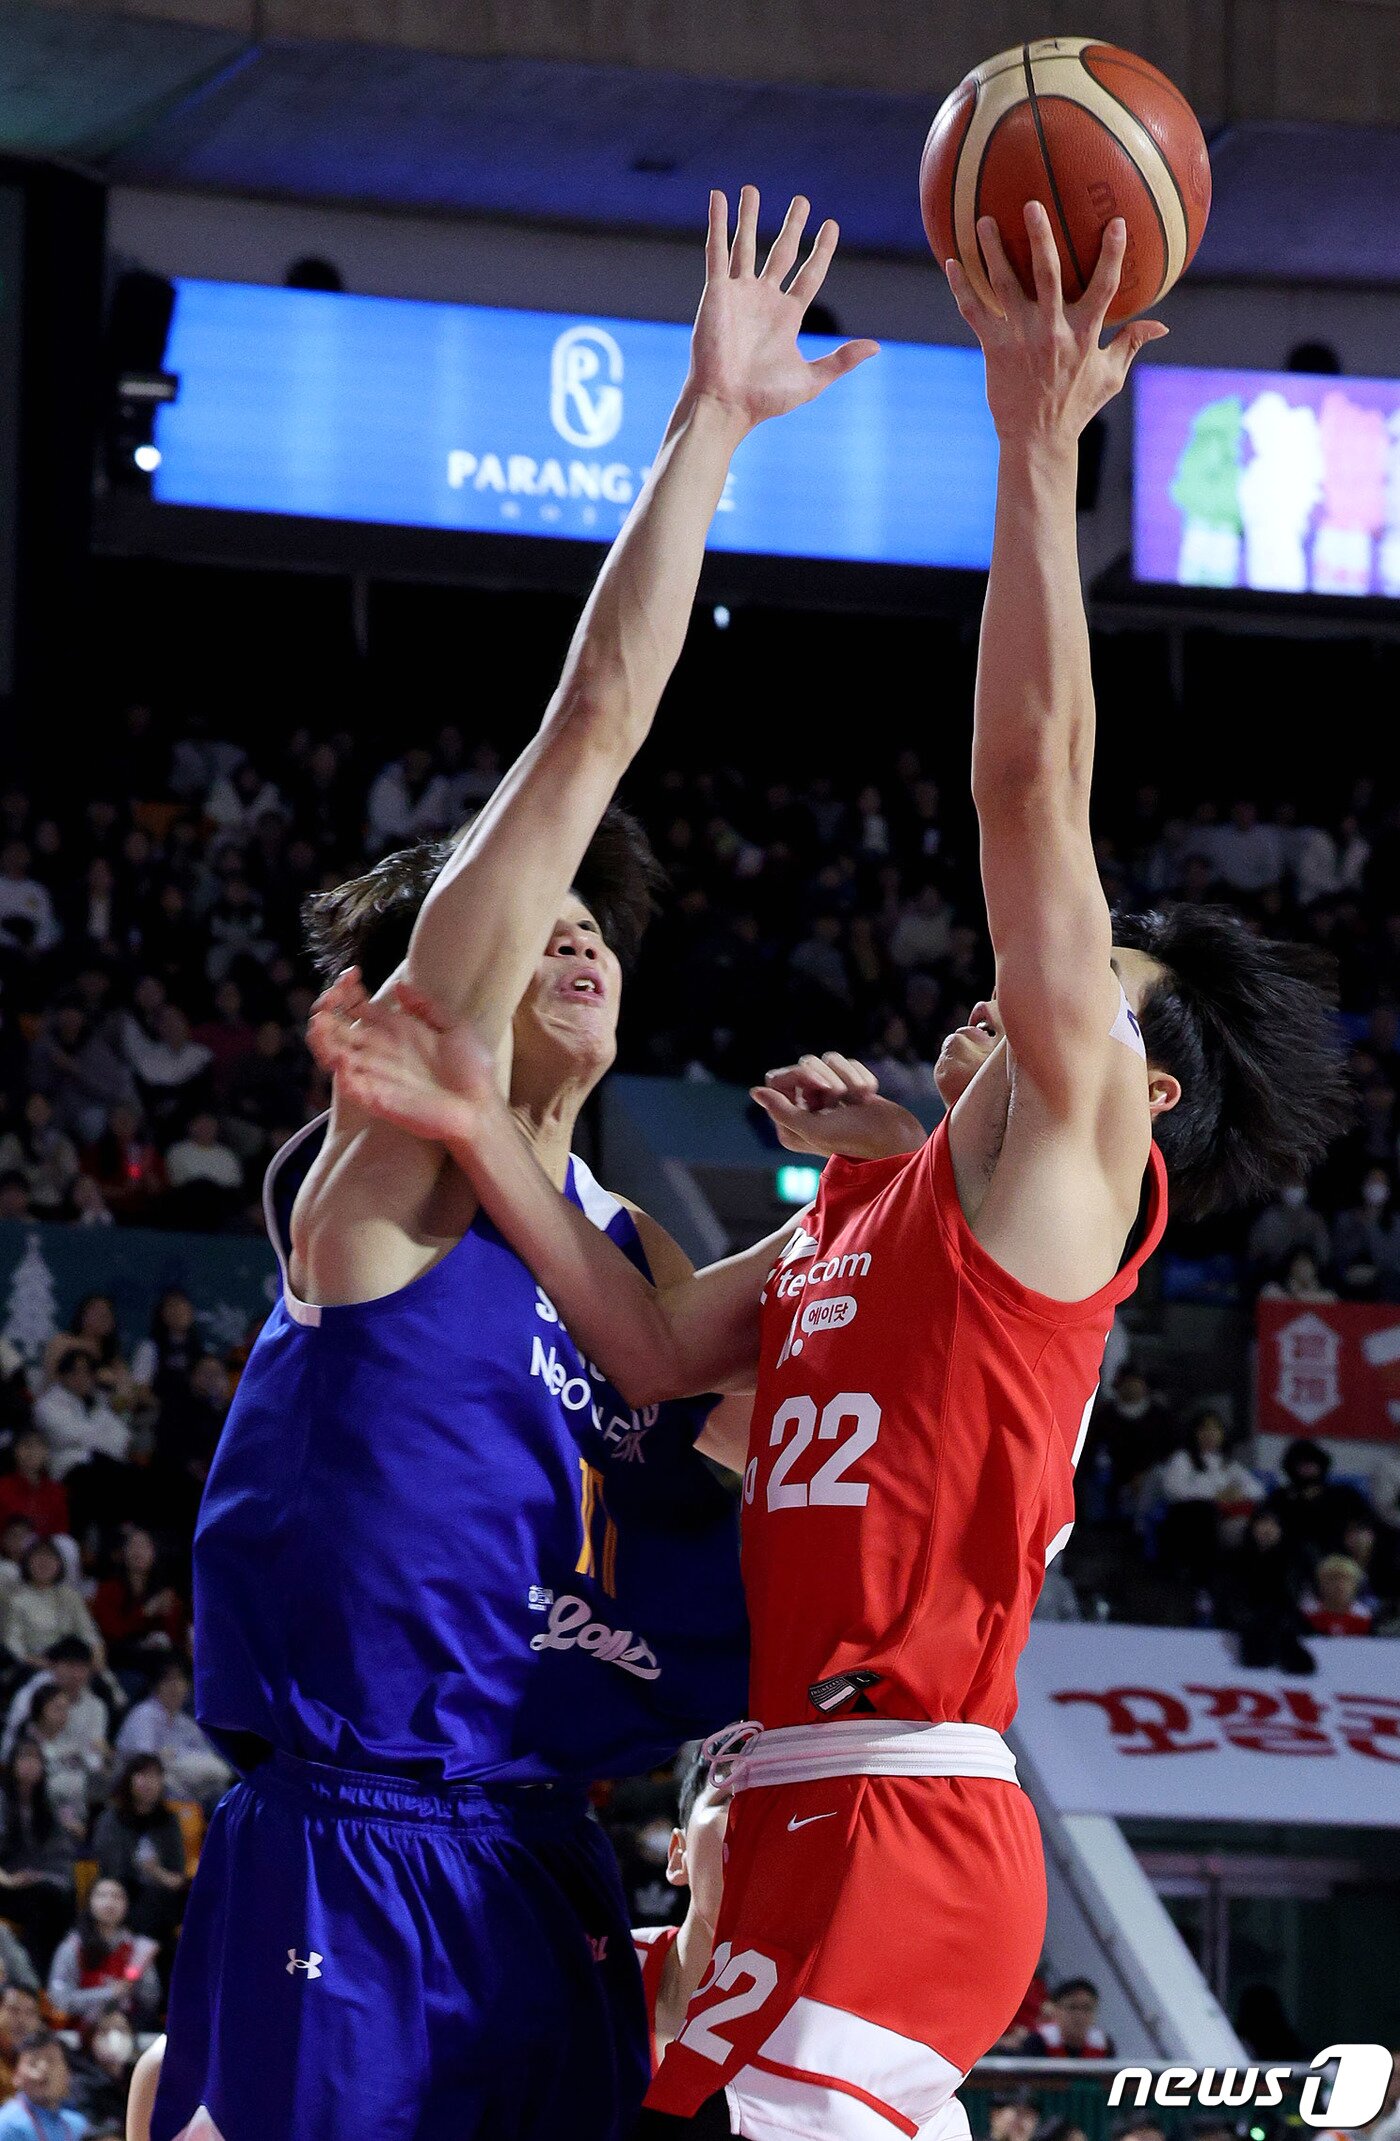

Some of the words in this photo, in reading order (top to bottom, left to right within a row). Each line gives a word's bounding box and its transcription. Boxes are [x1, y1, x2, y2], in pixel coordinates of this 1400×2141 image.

[447, 449, 634, 504] PARANG
[808, 1302, 849, 1327] 에이닷
[767, 1392, 882, 1513] 22
